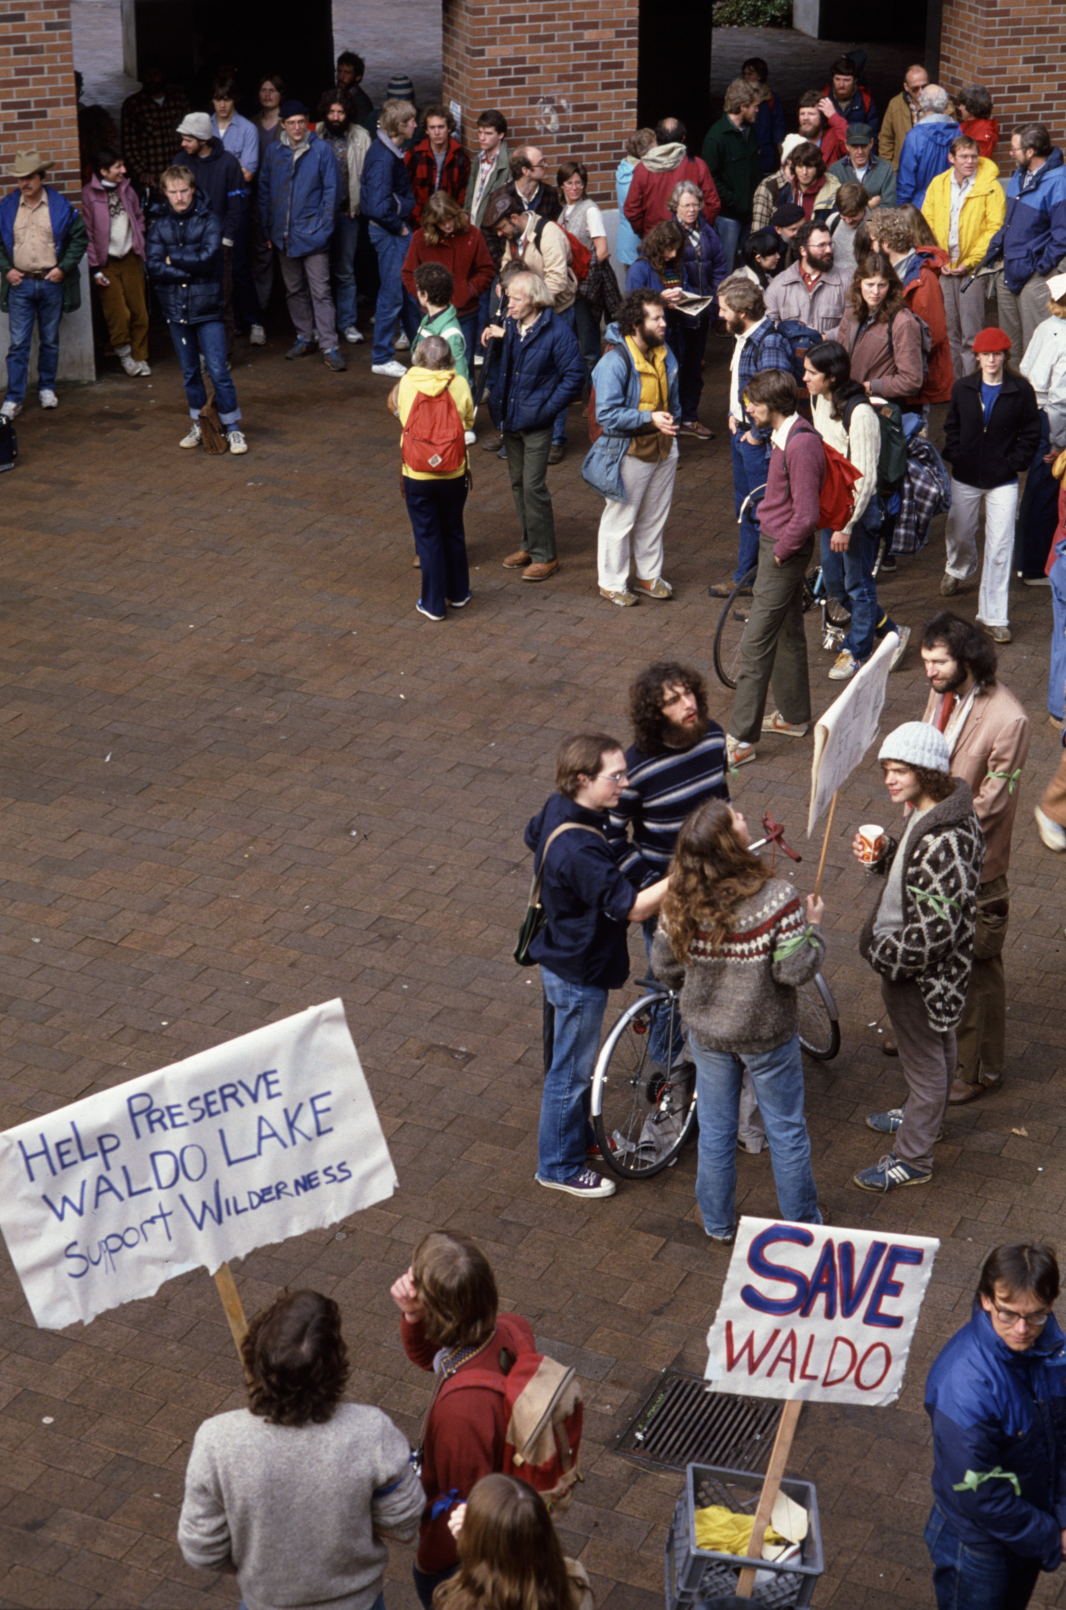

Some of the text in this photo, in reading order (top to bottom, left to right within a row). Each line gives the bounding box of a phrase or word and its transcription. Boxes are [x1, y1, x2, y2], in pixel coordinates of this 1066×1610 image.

[127, 1069, 283, 1140] PRESERVE
[42, 1091, 334, 1222] WALDO LAKE
[179, 1161, 353, 1231] WILDERNESS
[740, 1223, 925, 1328] SAVE
[725, 1320, 892, 1391] WALDO
